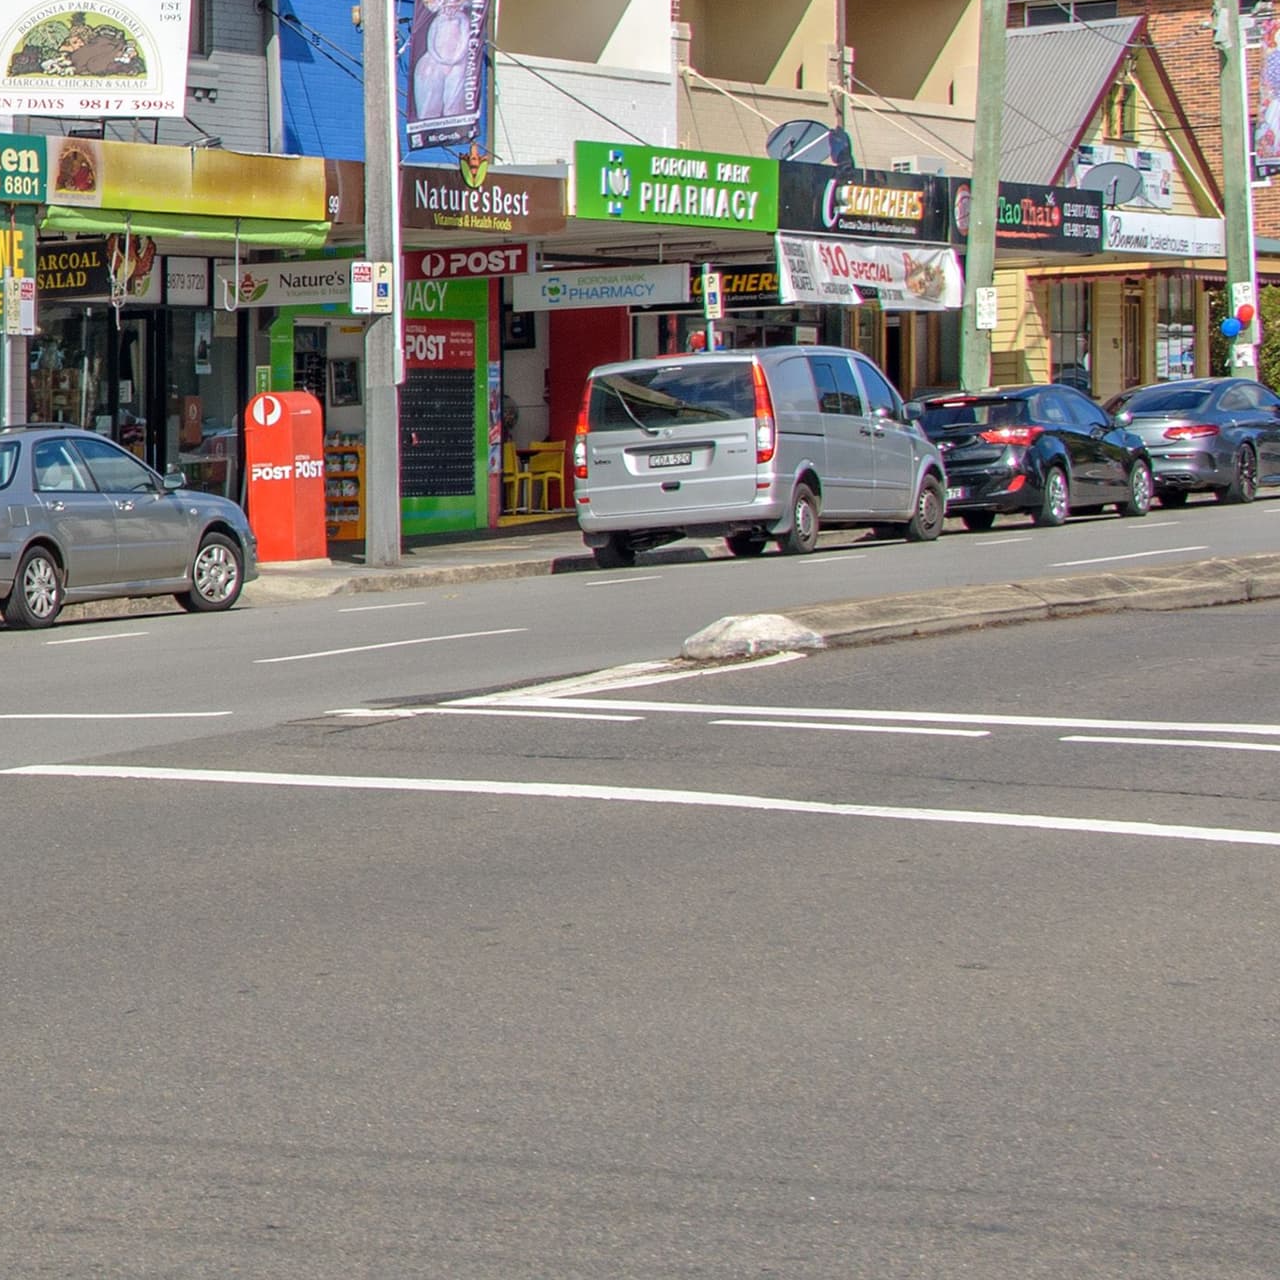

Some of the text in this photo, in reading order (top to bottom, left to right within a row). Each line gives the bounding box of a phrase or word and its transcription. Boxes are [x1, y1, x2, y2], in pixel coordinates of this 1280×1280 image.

[160, 2, 182, 11] EST
[18, 0, 146, 41] BORONIA PARK GOURMET
[469, 11, 482, 35] Art
[1, 78, 148, 89] CHARCOAL CHICKEN & SALAD
[16, 98, 25, 109] 7
[27, 98, 65, 110] DAYS
[79, 99, 176, 111] 9817 3998
[651, 156, 752, 184] BORONIA PARK
[4, 175, 40, 196] 6801
[328, 195, 340, 214] 99
[415, 179, 529, 216] Nature's Best
[639, 181, 759, 221] PHARMACY
[470, 215, 492, 229] Health
[493, 217, 513, 231] Foods
[37, 251, 101, 270] ARCOAL
[449, 249, 522, 275] POST
[819, 243, 849, 279] $10
[850, 259, 893, 284] SPECIAL
[37, 271, 87, 290] SALAD
[279, 271, 345, 289] Nature's
[577, 273, 646, 286] BORONIA PARK
[569, 283, 656, 301] PHARMACY
[405, 334, 446, 361] POST
[251, 465, 293, 482] POST
[294, 459, 324, 479] POST
